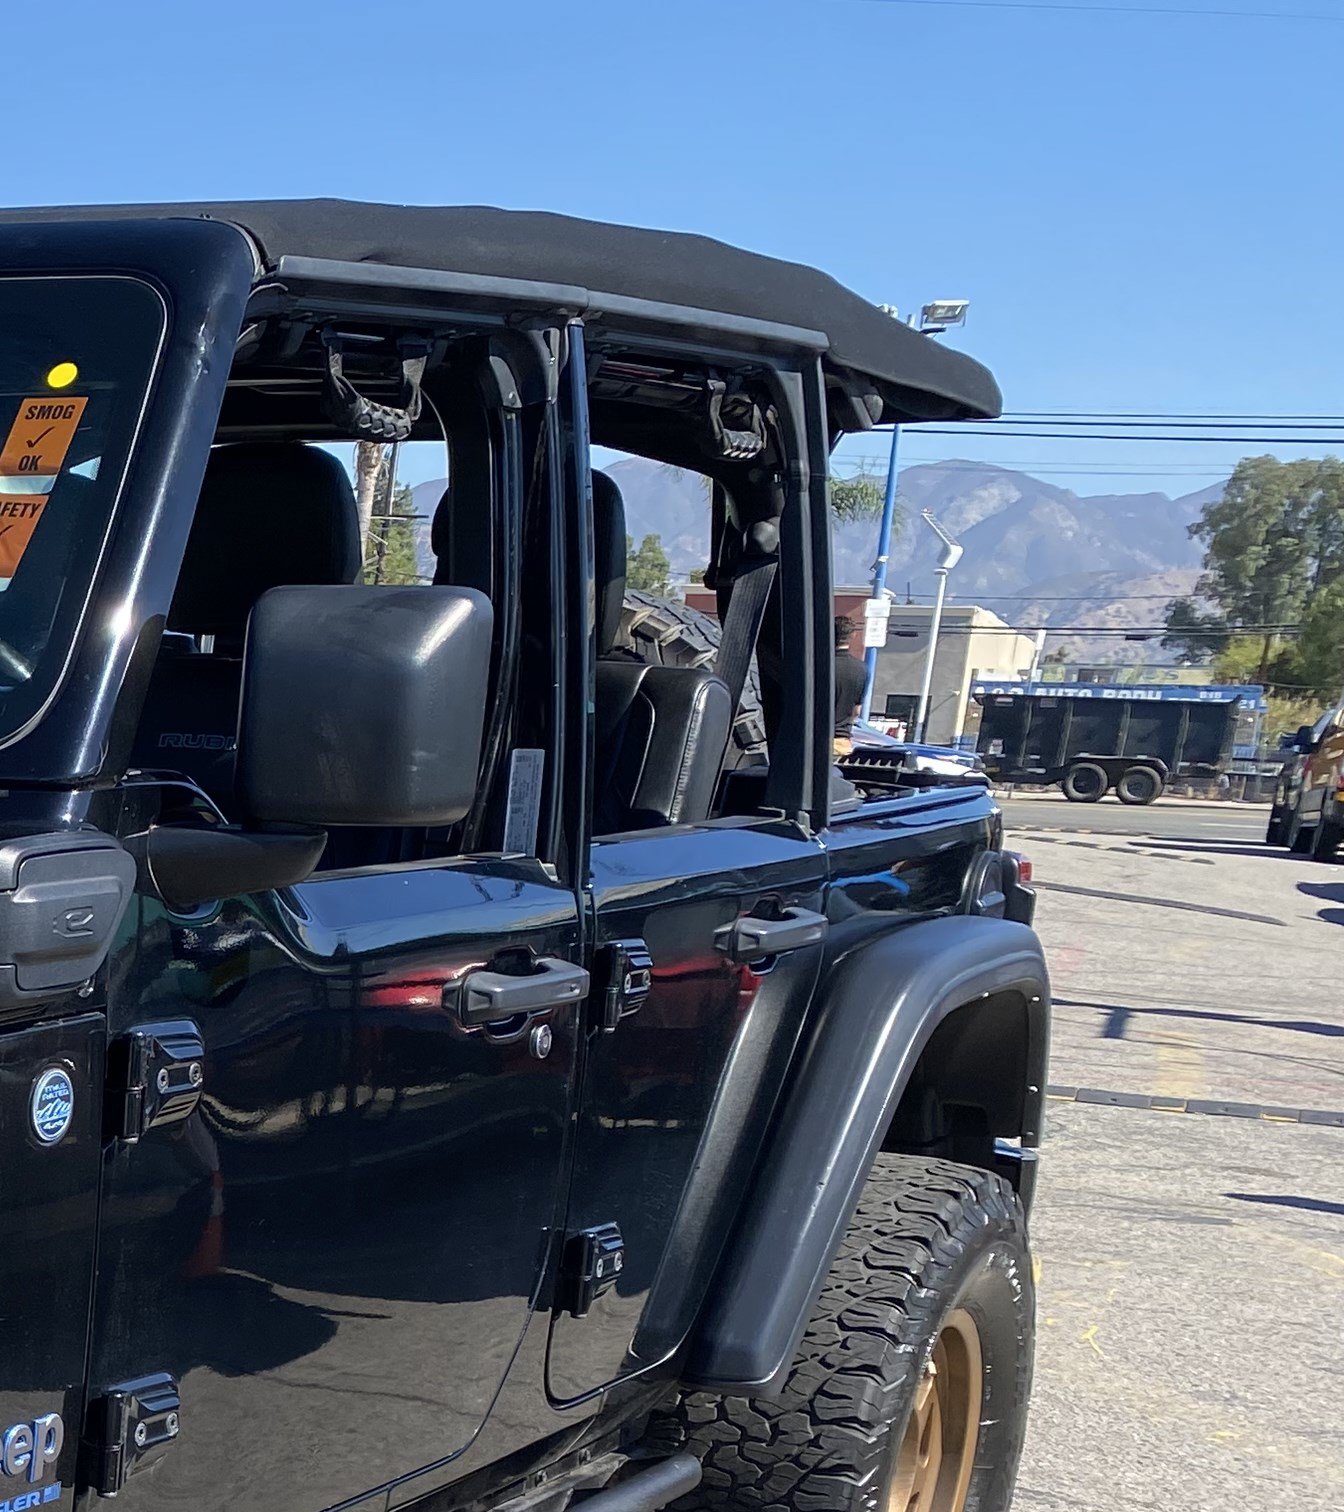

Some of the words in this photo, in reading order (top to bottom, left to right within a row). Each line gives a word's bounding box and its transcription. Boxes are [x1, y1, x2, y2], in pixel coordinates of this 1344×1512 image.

[25, 404, 75, 420] SMOG
[18, 455, 43, 472] OK
[158, 733, 235, 751] RUBI
